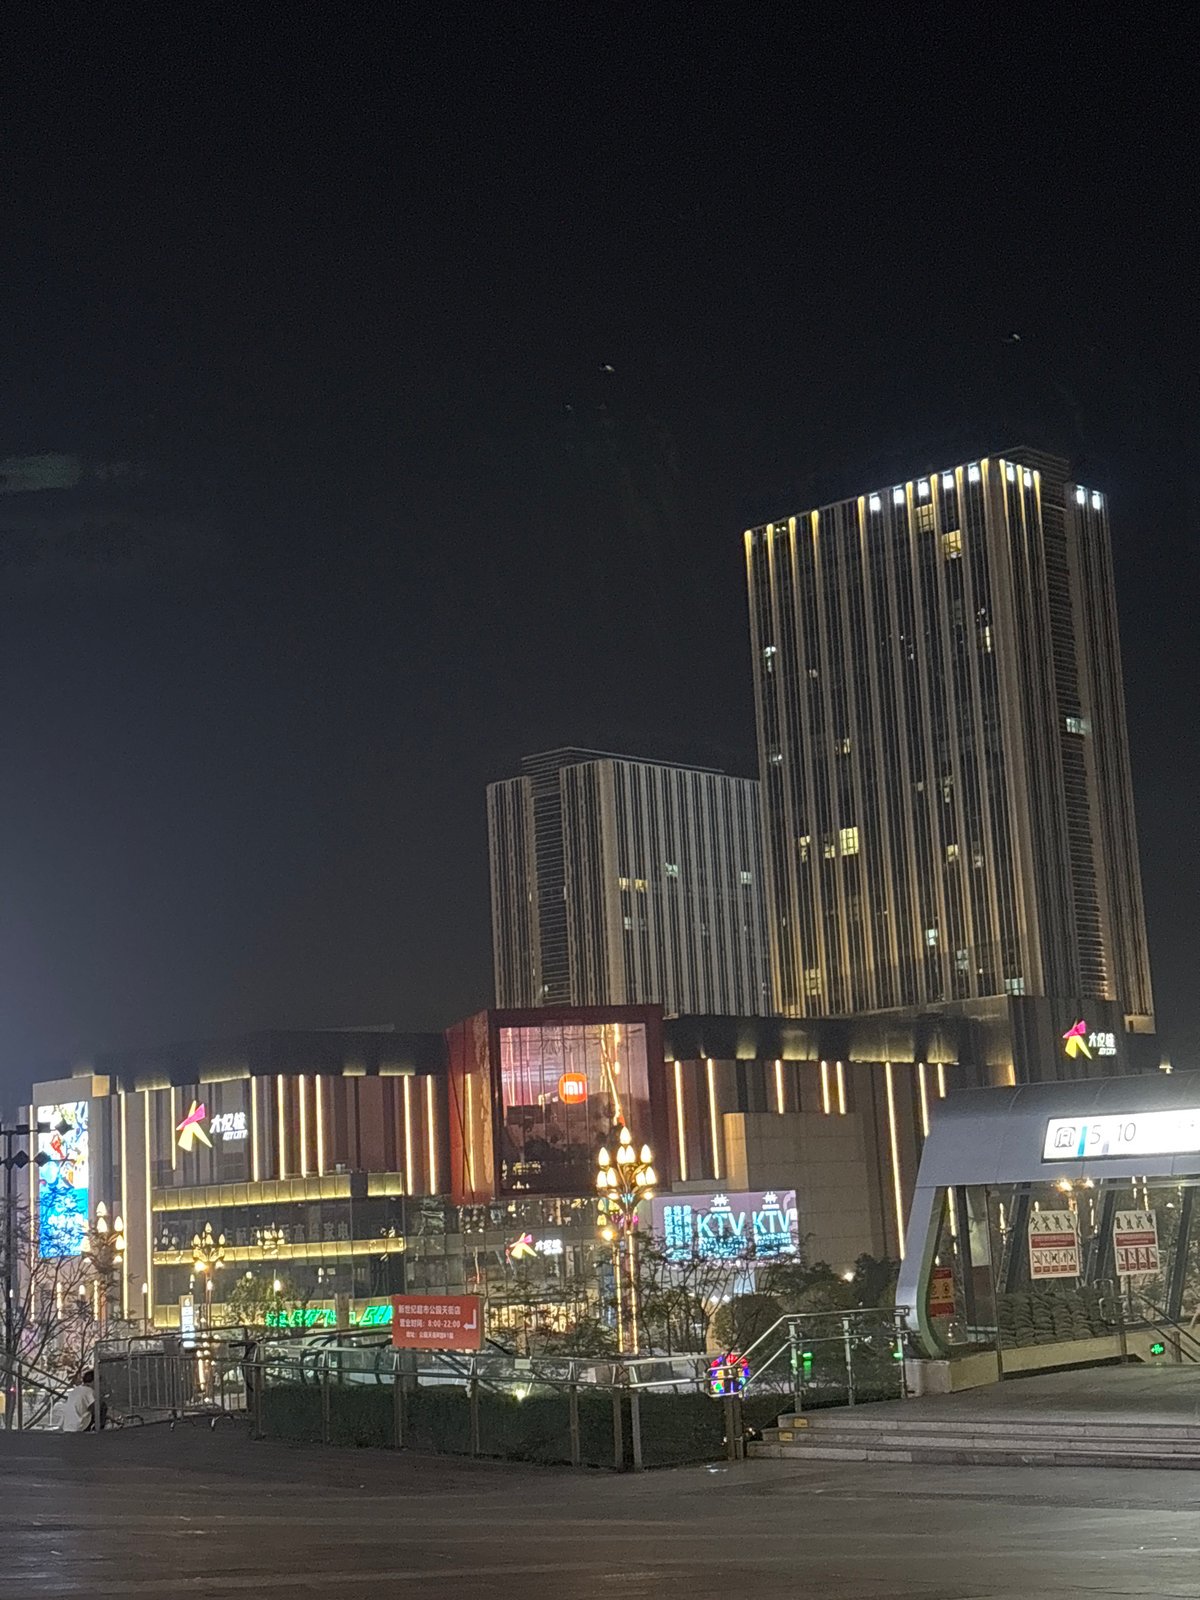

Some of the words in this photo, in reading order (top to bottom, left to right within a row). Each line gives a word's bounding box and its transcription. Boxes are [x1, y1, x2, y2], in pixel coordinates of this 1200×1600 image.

[1088, 1032, 1115, 1048] 大悦城
[209, 1112, 246, 1134] 大悦城
[1090, 1124, 1102, 1145] 5
[1117, 1122, 1137, 1142] 10
[697, 1211, 746, 1237] KTV
[752, 1210, 792, 1234] KTV
[398, 1305, 461, 1315] 新世纪超市公园天街店
[428, 1320, 461, 1328] 8:00-22:00
